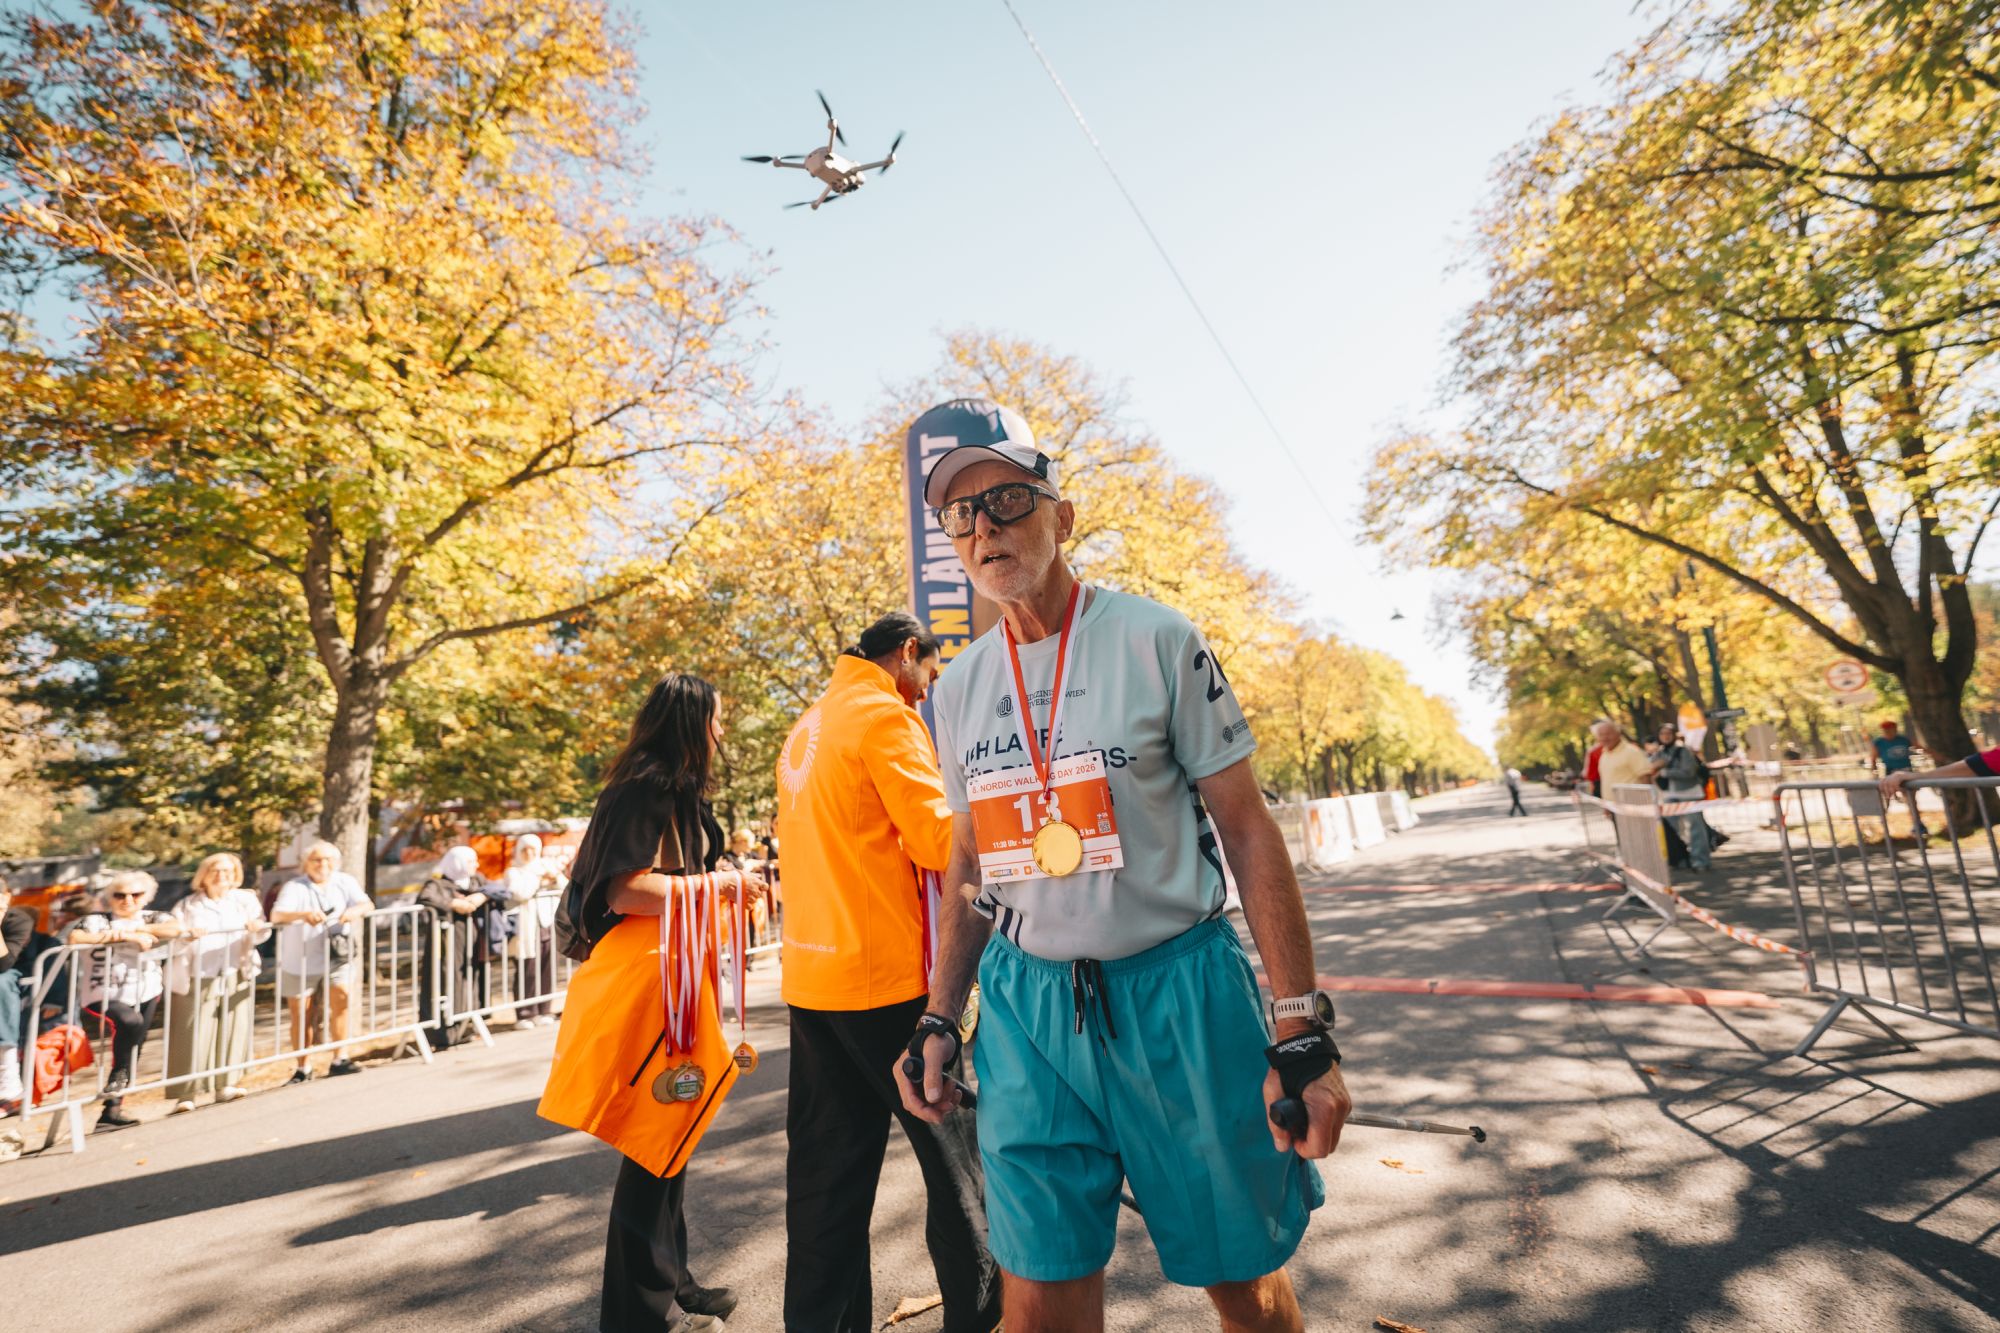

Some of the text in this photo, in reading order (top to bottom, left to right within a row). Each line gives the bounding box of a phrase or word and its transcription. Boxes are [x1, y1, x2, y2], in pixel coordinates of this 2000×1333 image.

[1065, 688, 1086, 698] WIEN
[980, 779, 1013, 793] NORDIC
[1057, 768, 1074, 779] DAY
[1075, 763, 1096, 775] 2026
[1013, 791, 1063, 833] 13
[1085, 826, 1096, 835] km
